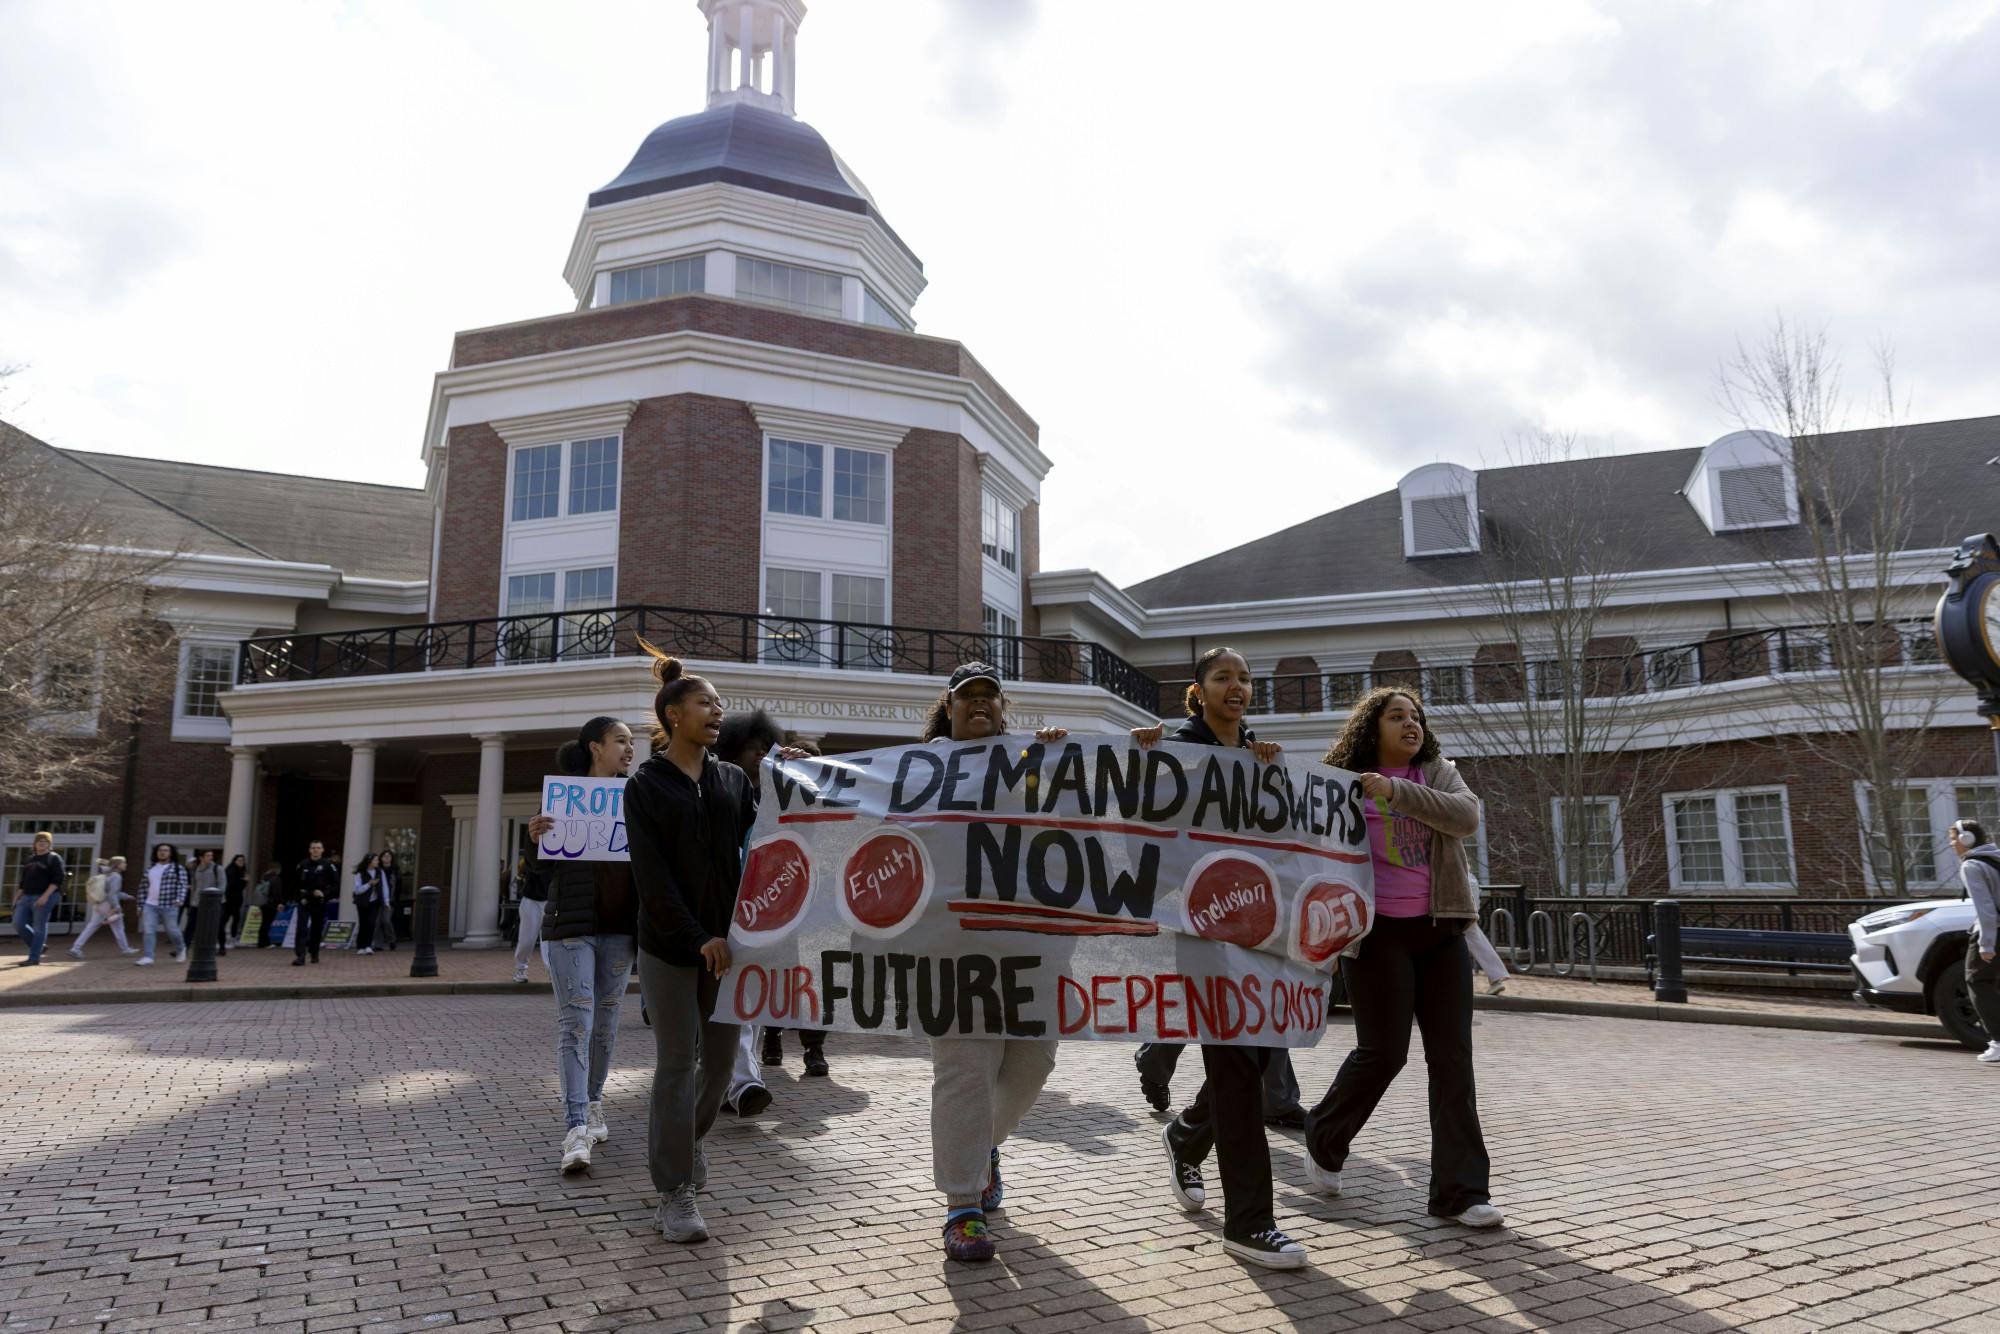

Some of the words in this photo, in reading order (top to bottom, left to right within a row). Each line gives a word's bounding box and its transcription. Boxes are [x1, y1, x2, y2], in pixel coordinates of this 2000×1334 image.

[720, 695, 756, 712] OHN
[762, 698, 844, 717] CALHOUN
[849, 703, 899, 719] BAKER
[1004, 711, 1046, 726] NTER
[546, 782, 624, 818] PROT
[772, 754, 873, 811] WE
[888, 743, 1188, 822] DEMAND
[1192, 754, 1367, 846] ANSWERS
[740, 853, 808, 928] Diversity
[849, 842, 917, 901] Equity
[966, 822, 1160, 918] NOW
[1307, 892, 1364, 947] DEI
[733, 963, 820, 1022] OUR
[821, 950, 1047, 1038] FUTURE
[1057, 974, 1266, 1041] DEPENDS
